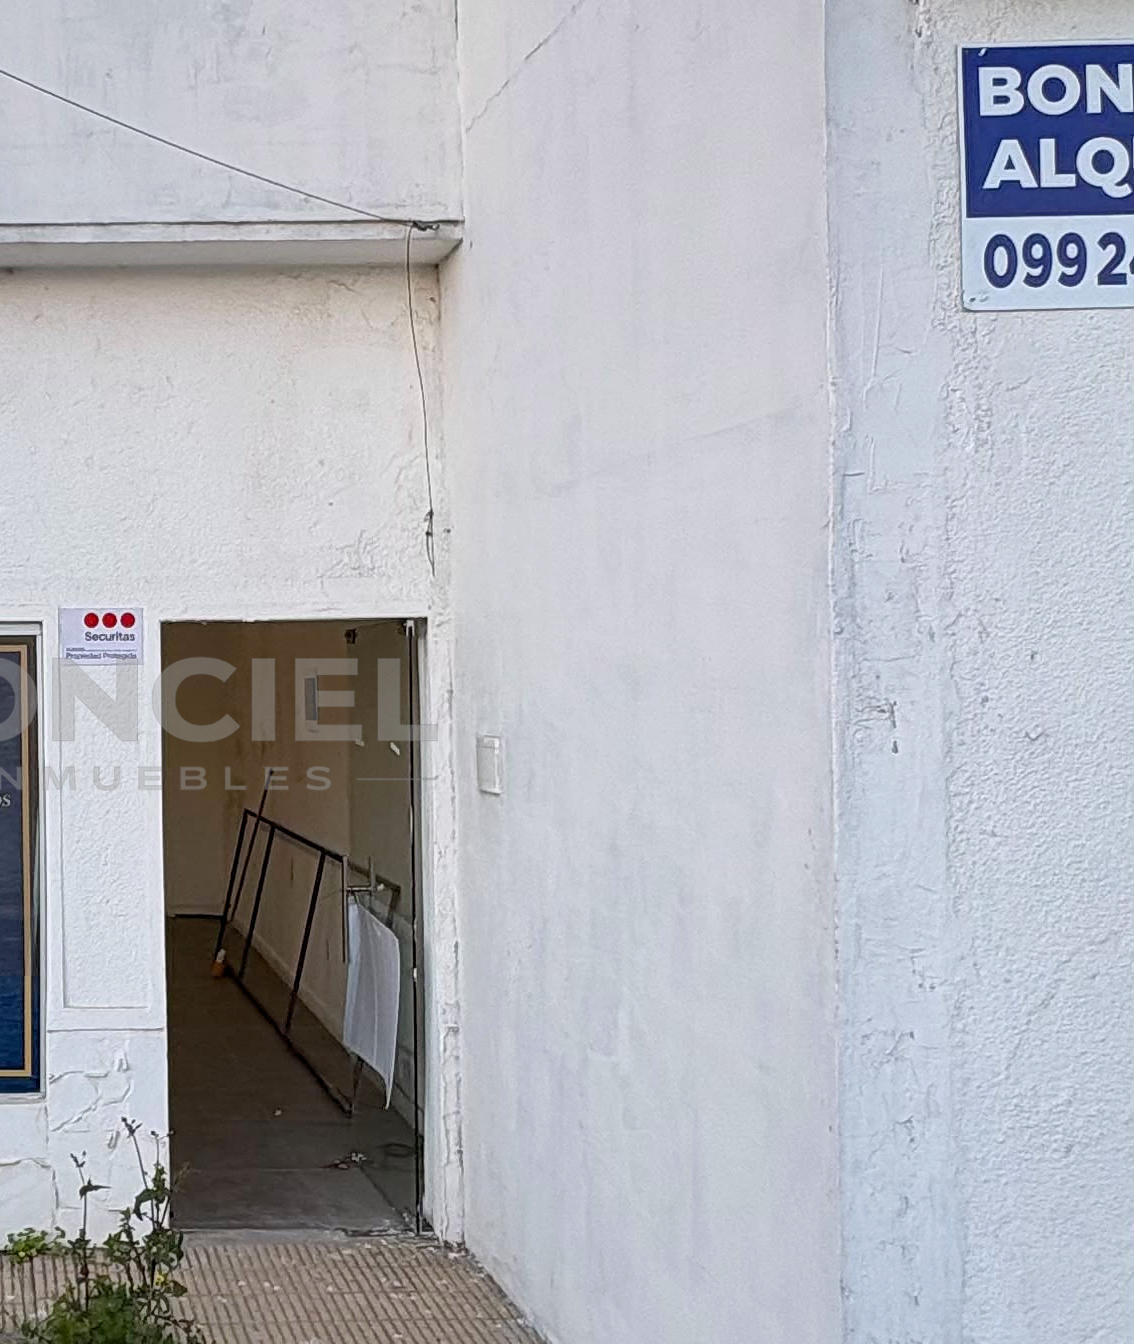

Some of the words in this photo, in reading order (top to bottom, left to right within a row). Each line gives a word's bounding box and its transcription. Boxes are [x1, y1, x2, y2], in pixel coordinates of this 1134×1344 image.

[978, 63, 1134, 117] BON
[982, 137, 1134, 199] ALQ
[983, 232, 1088, 288] 099
[1096, 232, 1134, 285] 2
[84, 631, 136, 642] Securitas
